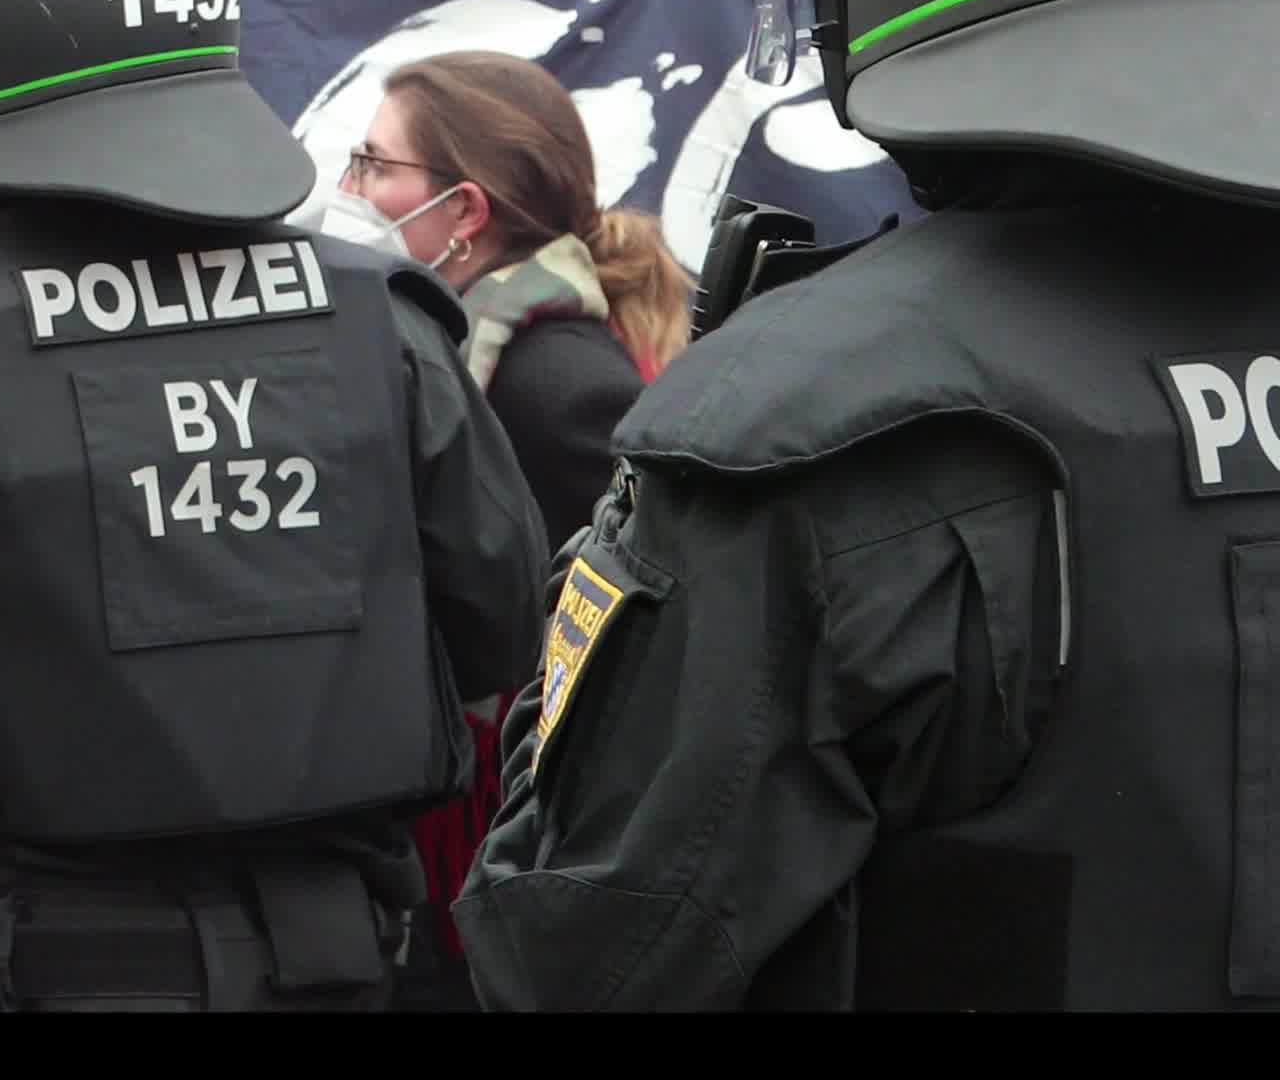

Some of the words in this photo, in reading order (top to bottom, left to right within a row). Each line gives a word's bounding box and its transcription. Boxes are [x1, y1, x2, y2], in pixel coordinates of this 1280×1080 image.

[22, 241, 329, 337] POLIZEI
[163, 377, 258, 453] BY
[130, 457, 321, 537] 1432
